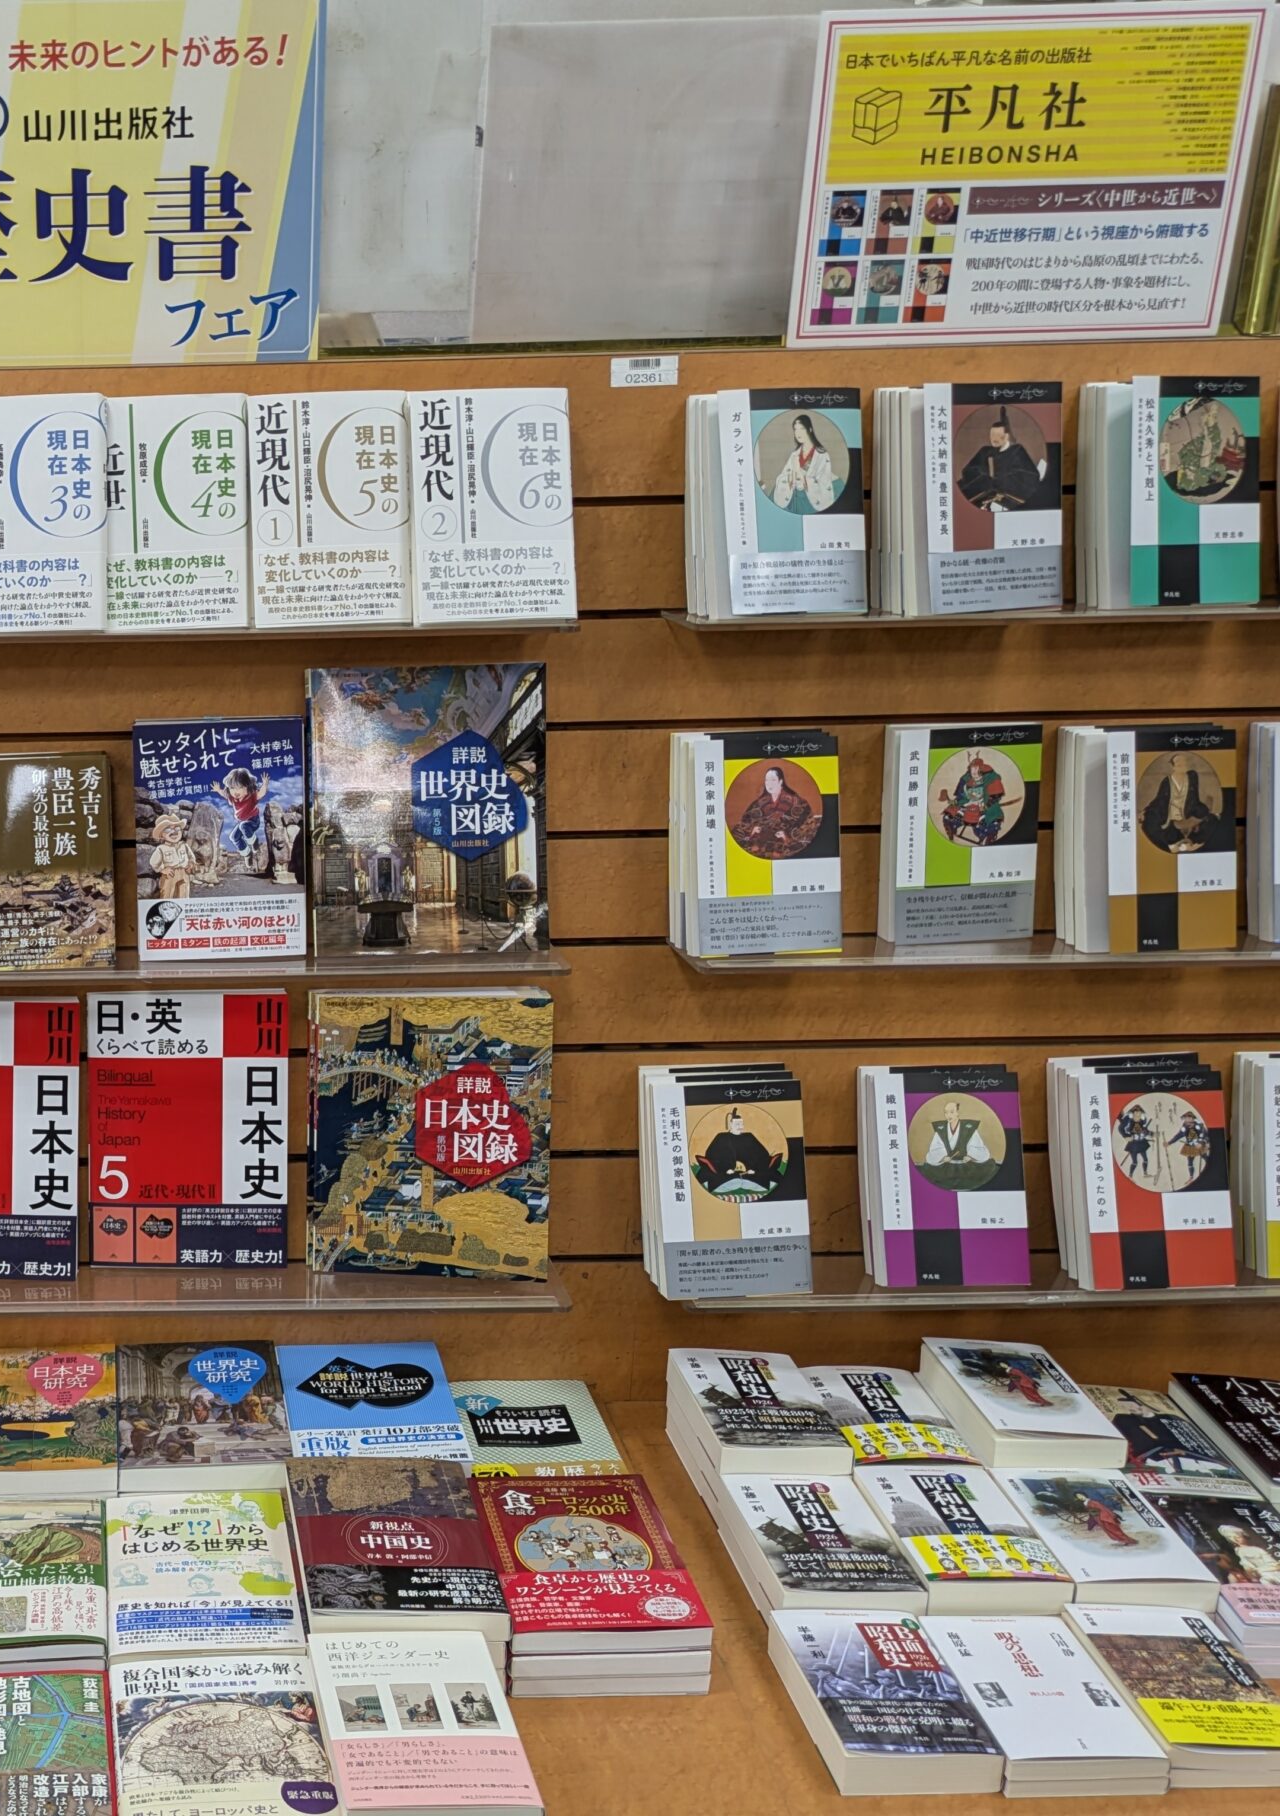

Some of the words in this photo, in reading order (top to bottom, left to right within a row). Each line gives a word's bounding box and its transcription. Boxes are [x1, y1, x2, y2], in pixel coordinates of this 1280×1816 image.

[845, 48, 1092, 70] 日本でいちばん平凡な名前の出版社
[23, 106, 195, 142] 山川出版社
[924, 81, 1087, 133] 平凡社
[920, 144, 1079, 165] HEIBONSHA
[164, 288, 298, 346] フェア
[625, 373, 662, 383] 02361
[47, 430, 68, 476] 現在
[192, 430, 213, 475] 現在
[257, 402, 291, 507] 近現代
[354, 426, 376, 470] 現在
[420, 398, 454, 502] 近現代
[518, 423, 538, 467] 現在
[732, 411, 744, 467] ガラシャ
[71, 430, 92, 522] 日本史の
[217, 430, 236, 519] 日本史の
[379, 426, 400, 515] 日本史の
[543, 422, 562, 510] 日本史の
[44, 485, 67, 522] 3
[191, 482, 213, 518] 4
[353, 479, 377, 517] 5
[519, 472, 544, 509] 6
[138, 727, 240, 755] ヒッタイトに
[452, 747, 487, 763] 詳説
[140, 751, 236, 778] 魅せられて
[908, 750, 921, 807] 武田勝頼
[78, 766, 102, 838] 秀吉と
[420, 769, 508, 801] 世界史
[52, 767, 77, 856] 豊臣一族
[451, 802, 515, 835] 図録
[47, 1006, 73, 1063] 山川
[97, 999, 182, 1035] 日・英
[256, 1000, 283, 1055] 山川
[95, 1038, 209, 1055] くらべて読める
[97, 1069, 153, 1084] Bilingual
[457, 1077, 492, 1094] 詳説
[97, 1107, 145, 1121] History
[423, 1099, 511, 1130] 日本史
[886, 1094, 900, 1151] 織田信長
[29, 1074, 74, 1211] 日本史
[98, 1132, 141, 1148] Japan
[240, 1066, 284, 1200] 日本史
[453, 1132, 518, 1164] 図録
[98, 1156, 129, 1199] 5
[32, 1362, 96, 1380] 日本史
[42, 1376, 86, 1389] 研究
[195, 1359, 261, 1372] 世界史
[206, 1370, 252, 1382] 研究
[310, 1379, 367, 1389] WORLD
[370, 1376, 429, 1389] HISTORY
[724, 1359, 771, 1399] 昭和史
[336, 1386, 369, 1394] High
[371, 1383, 422, 1392] School
[464, 1396, 491, 1410] 新
[845, 1375, 900, 1411] 昭和史
[501, 1490, 534, 1510] 食
[532, 1496, 628, 1505] ヨーロッパ史
[567, 1504, 630, 1516] 2500年
[780, 1485, 835, 1532] 昭和史
[918, 1476, 976, 1521] 昭和史
[360, 1534, 433, 1551] 中国史
[368, 1521, 415, 1531] 新視点
[122, 1539, 269, 1554] はじめる世界史
[535, 1574, 650, 1585] 食卓から歴史の
[865, 1626, 911, 1667] 昭和史
[12, 1676, 32, 1726] 古地図と
[124, 1677, 181, 1696] 世界史
